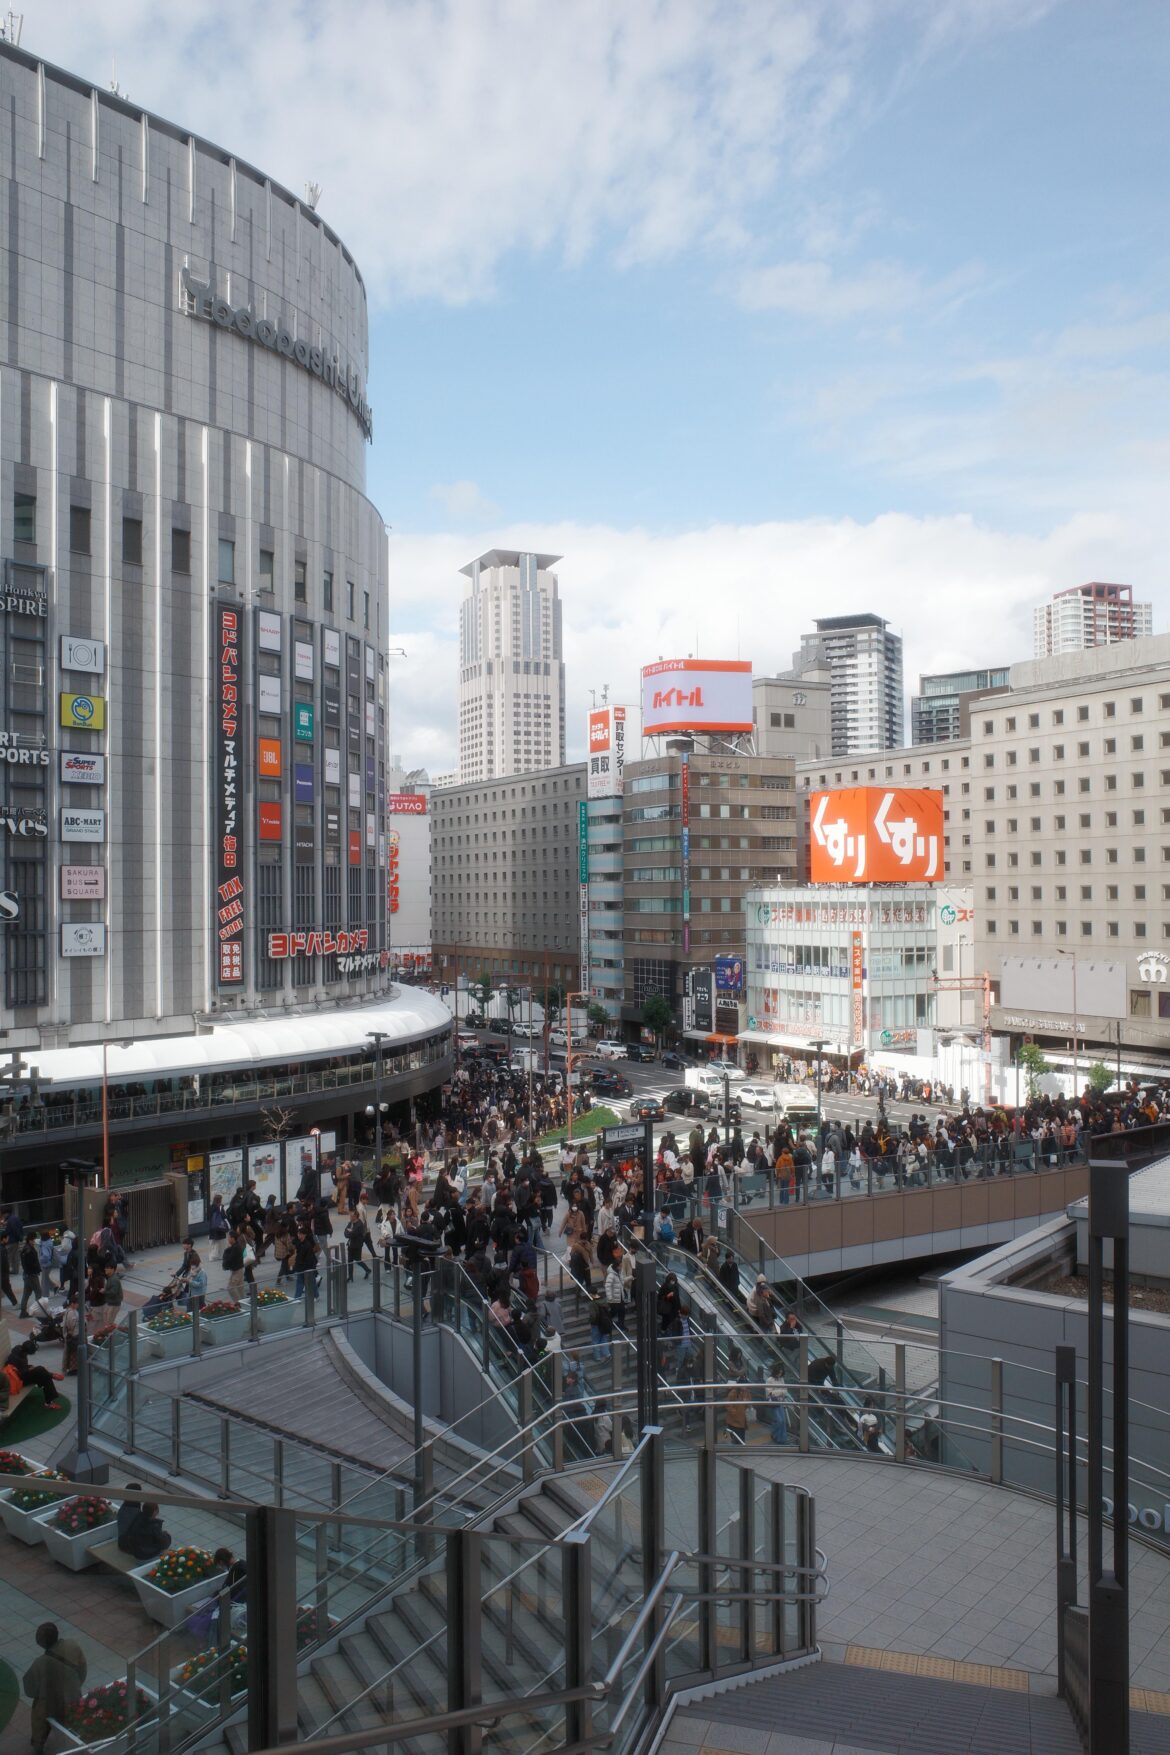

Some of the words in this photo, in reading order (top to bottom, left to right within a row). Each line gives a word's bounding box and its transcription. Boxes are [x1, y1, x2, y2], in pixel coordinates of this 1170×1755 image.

[5, 584, 47, 600] Hankyu
[653, 686, 704, 709] バイトル
[263, 751, 278, 764] JBL
[615, 721, 625, 776] 買取センター
[65, 762, 94, 771] SPORTS
[73, 757, 96, 766] SUPER
[591, 756, 610, 775] 買取
[64, 817, 102, 827] ABC-MART
[296, 841, 314, 849] HITACHI
[813, 796, 866, 878] くすり
[874, 793, 938, 877] くすり
[67, 869, 99, 877] SAKURA
[67, 888, 100, 896] SQUARE
[218, 876, 244, 902] TAX
[218, 899, 244, 924] FREE
[219, 918, 244, 940] STORE
[268, 929, 368, 958] ヨドバシカメラ
[222, 944, 231, 978] 取扱店
[232, 943, 241, 978] 免税品
[337, 950, 390, 972] マルチメディア梅
